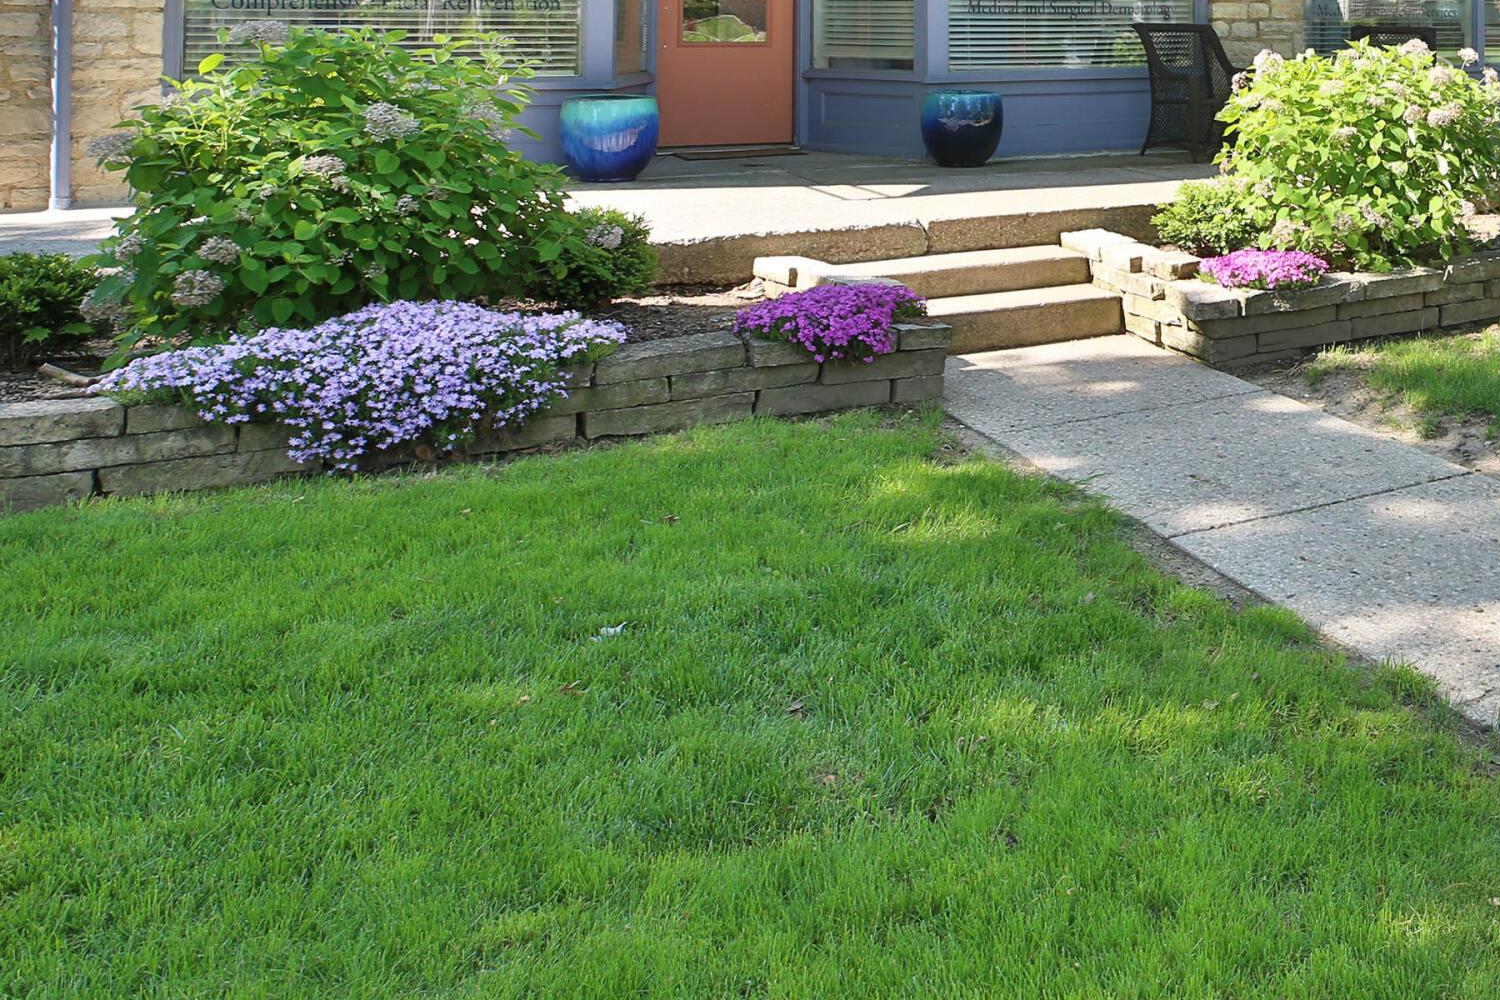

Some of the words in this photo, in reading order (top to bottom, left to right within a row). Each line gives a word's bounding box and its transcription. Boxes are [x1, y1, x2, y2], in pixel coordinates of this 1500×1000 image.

[967, 0, 1019, 15] Medical
[1022, 1, 1046, 15] and
[1050, 0, 1098, 19] Surgical
[1101, 1, 1176, 20] Dermtolog
